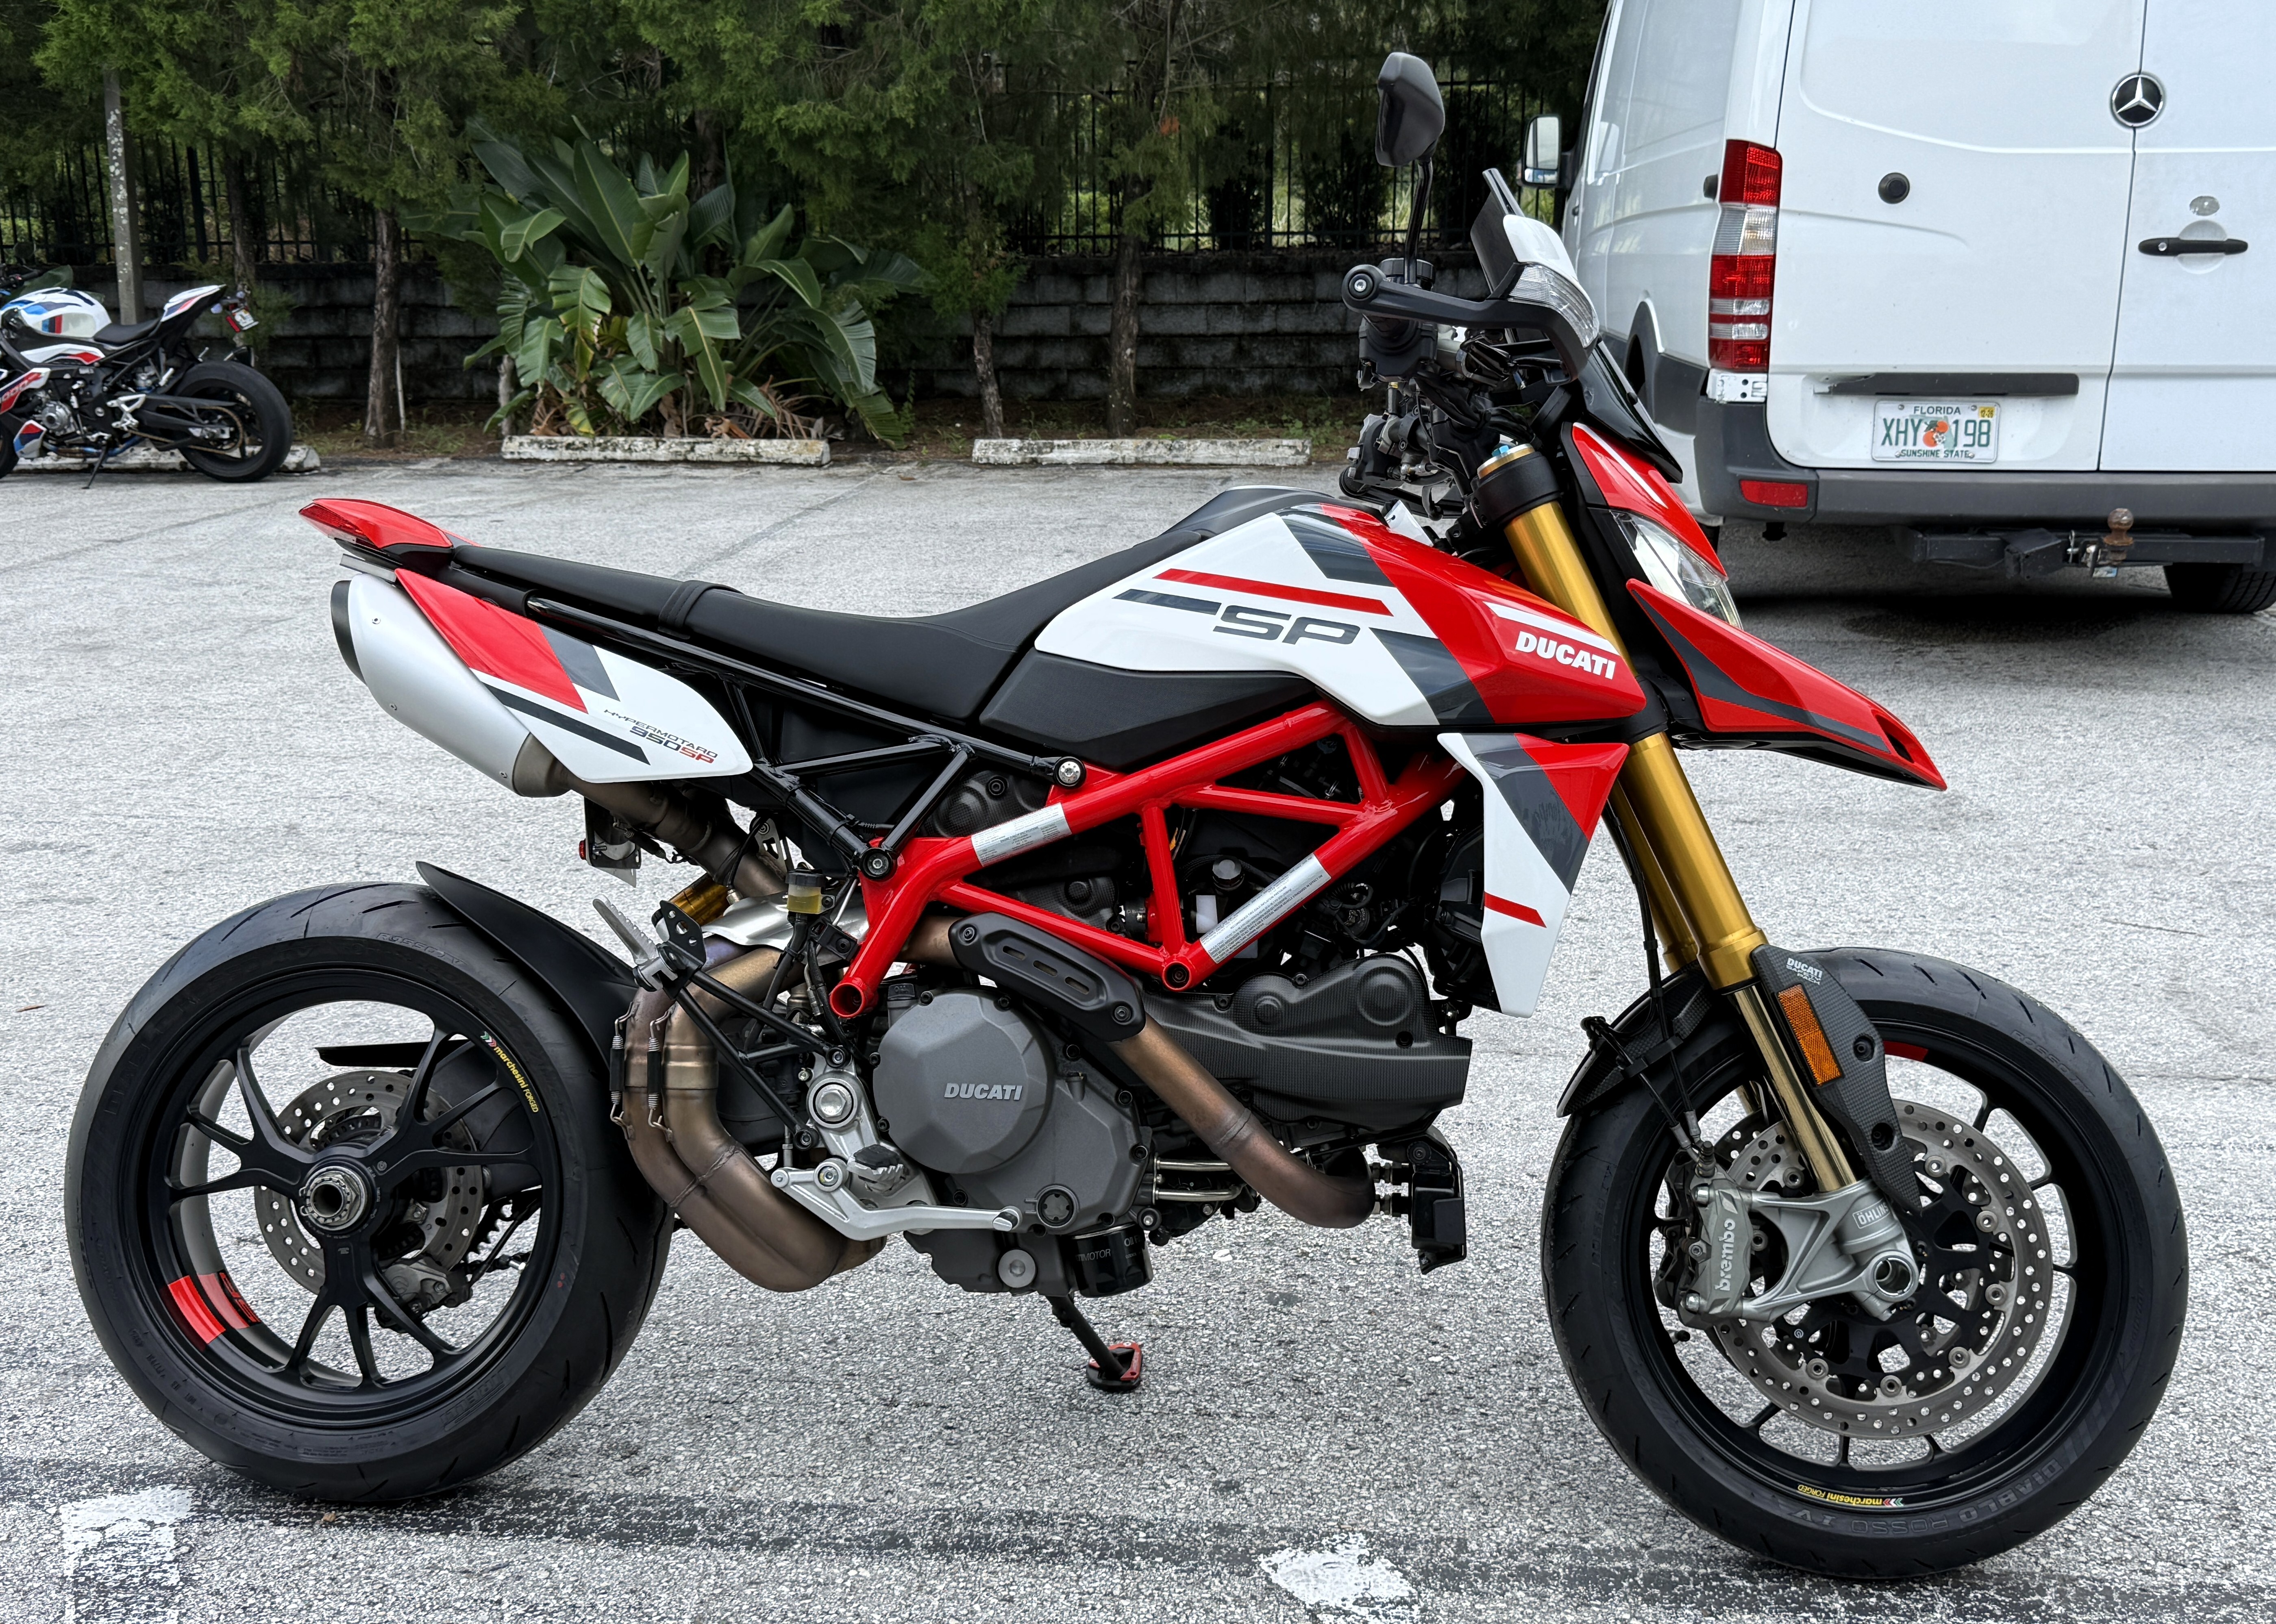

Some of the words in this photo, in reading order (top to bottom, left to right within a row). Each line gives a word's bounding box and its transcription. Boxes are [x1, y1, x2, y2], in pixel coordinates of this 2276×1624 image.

[1914, 406, 1960, 415] FLORIDA
[1881, 418, 1922, 446] XHY
[1952, 419, 1991, 447] 198
[1901, 449, 1940, 457] SUNSHINE
[1944, 450, 1969, 458] STATE
[1213, 605, 1360, 645] SP
[1515, 631, 1616, 680] DUCATI
[604, 709, 718, 758] HYPERMOTARD
[1786, 965, 1821, 980] SAFETY
[1787, 957, 1822, 978] DUCATI
[1797, 973, 1820, 985] PACK
[494, 1046, 528, 1088] marchesini
[523, 1089, 539, 1113] FORGED
[944, 1083, 1023, 1100] DUCATI
[1857, 1202, 1889, 1225] ÖHLINS
[1715, 1219, 1736, 1291] brembo
[1797, 1484, 1826, 1498] FORGED
[1826, 1493, 1882, 1506] marchesini
[1958, 1458, 2065, 1522] DIABLO
[1852, 1513, 1949, 1534] ROSSO
